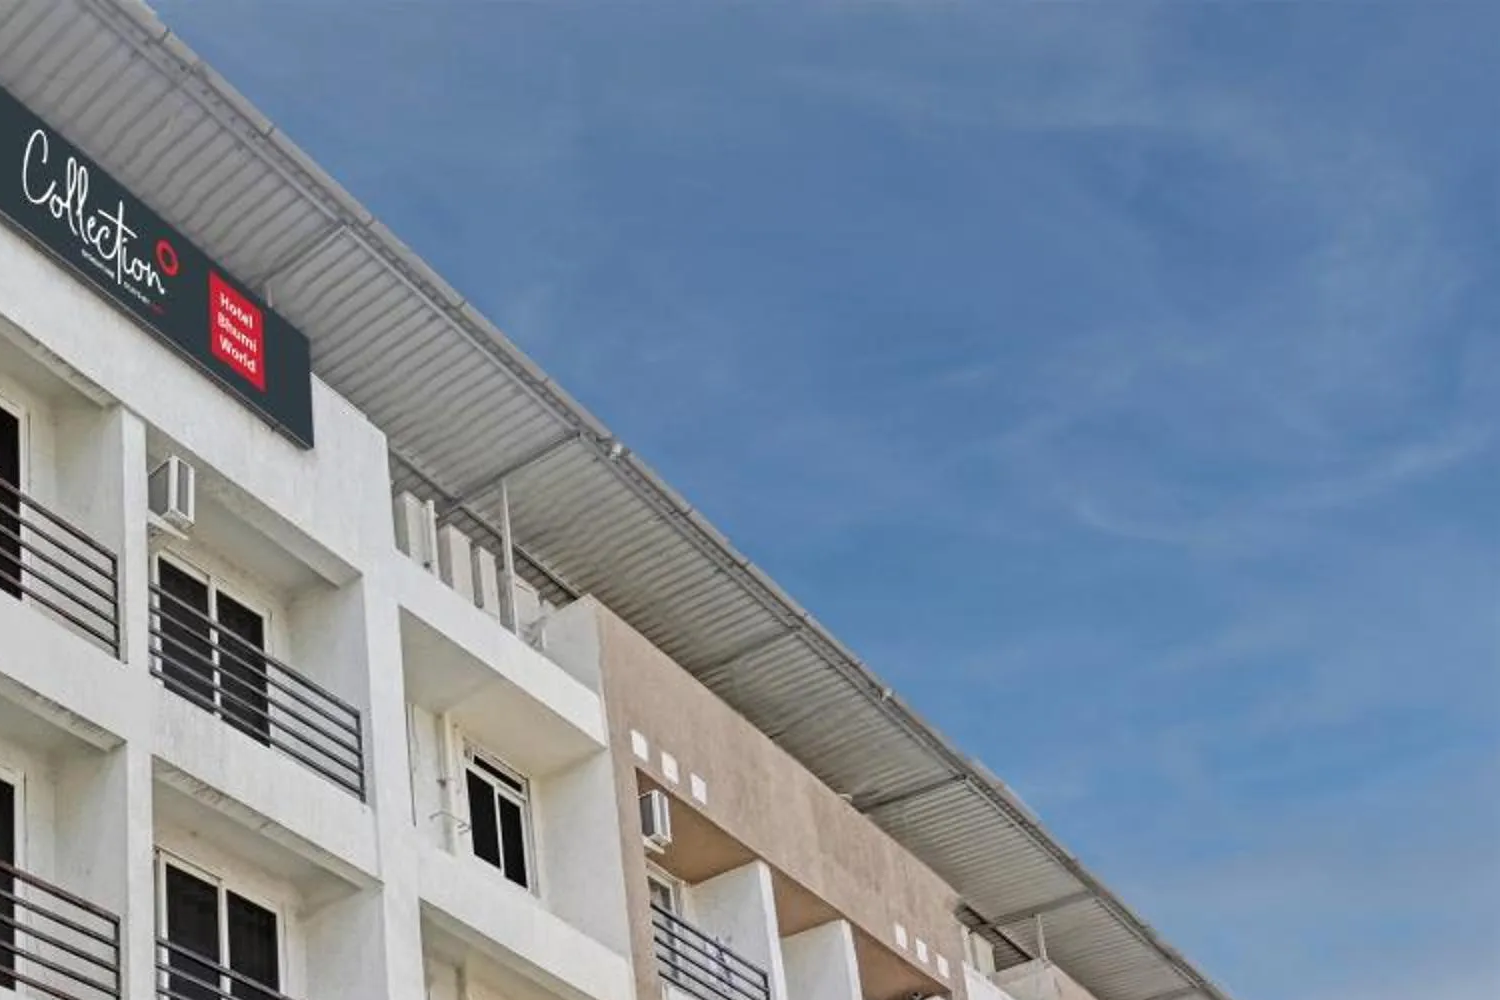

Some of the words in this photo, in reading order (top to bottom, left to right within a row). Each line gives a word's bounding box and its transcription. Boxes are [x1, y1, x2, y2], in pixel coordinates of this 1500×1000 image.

[22, 128, 165, 295] Collection
[220, 291, 253, 329] Hotel
[217, 311, 257, 353] Bhumi
[219, 333, 257, 373] World
